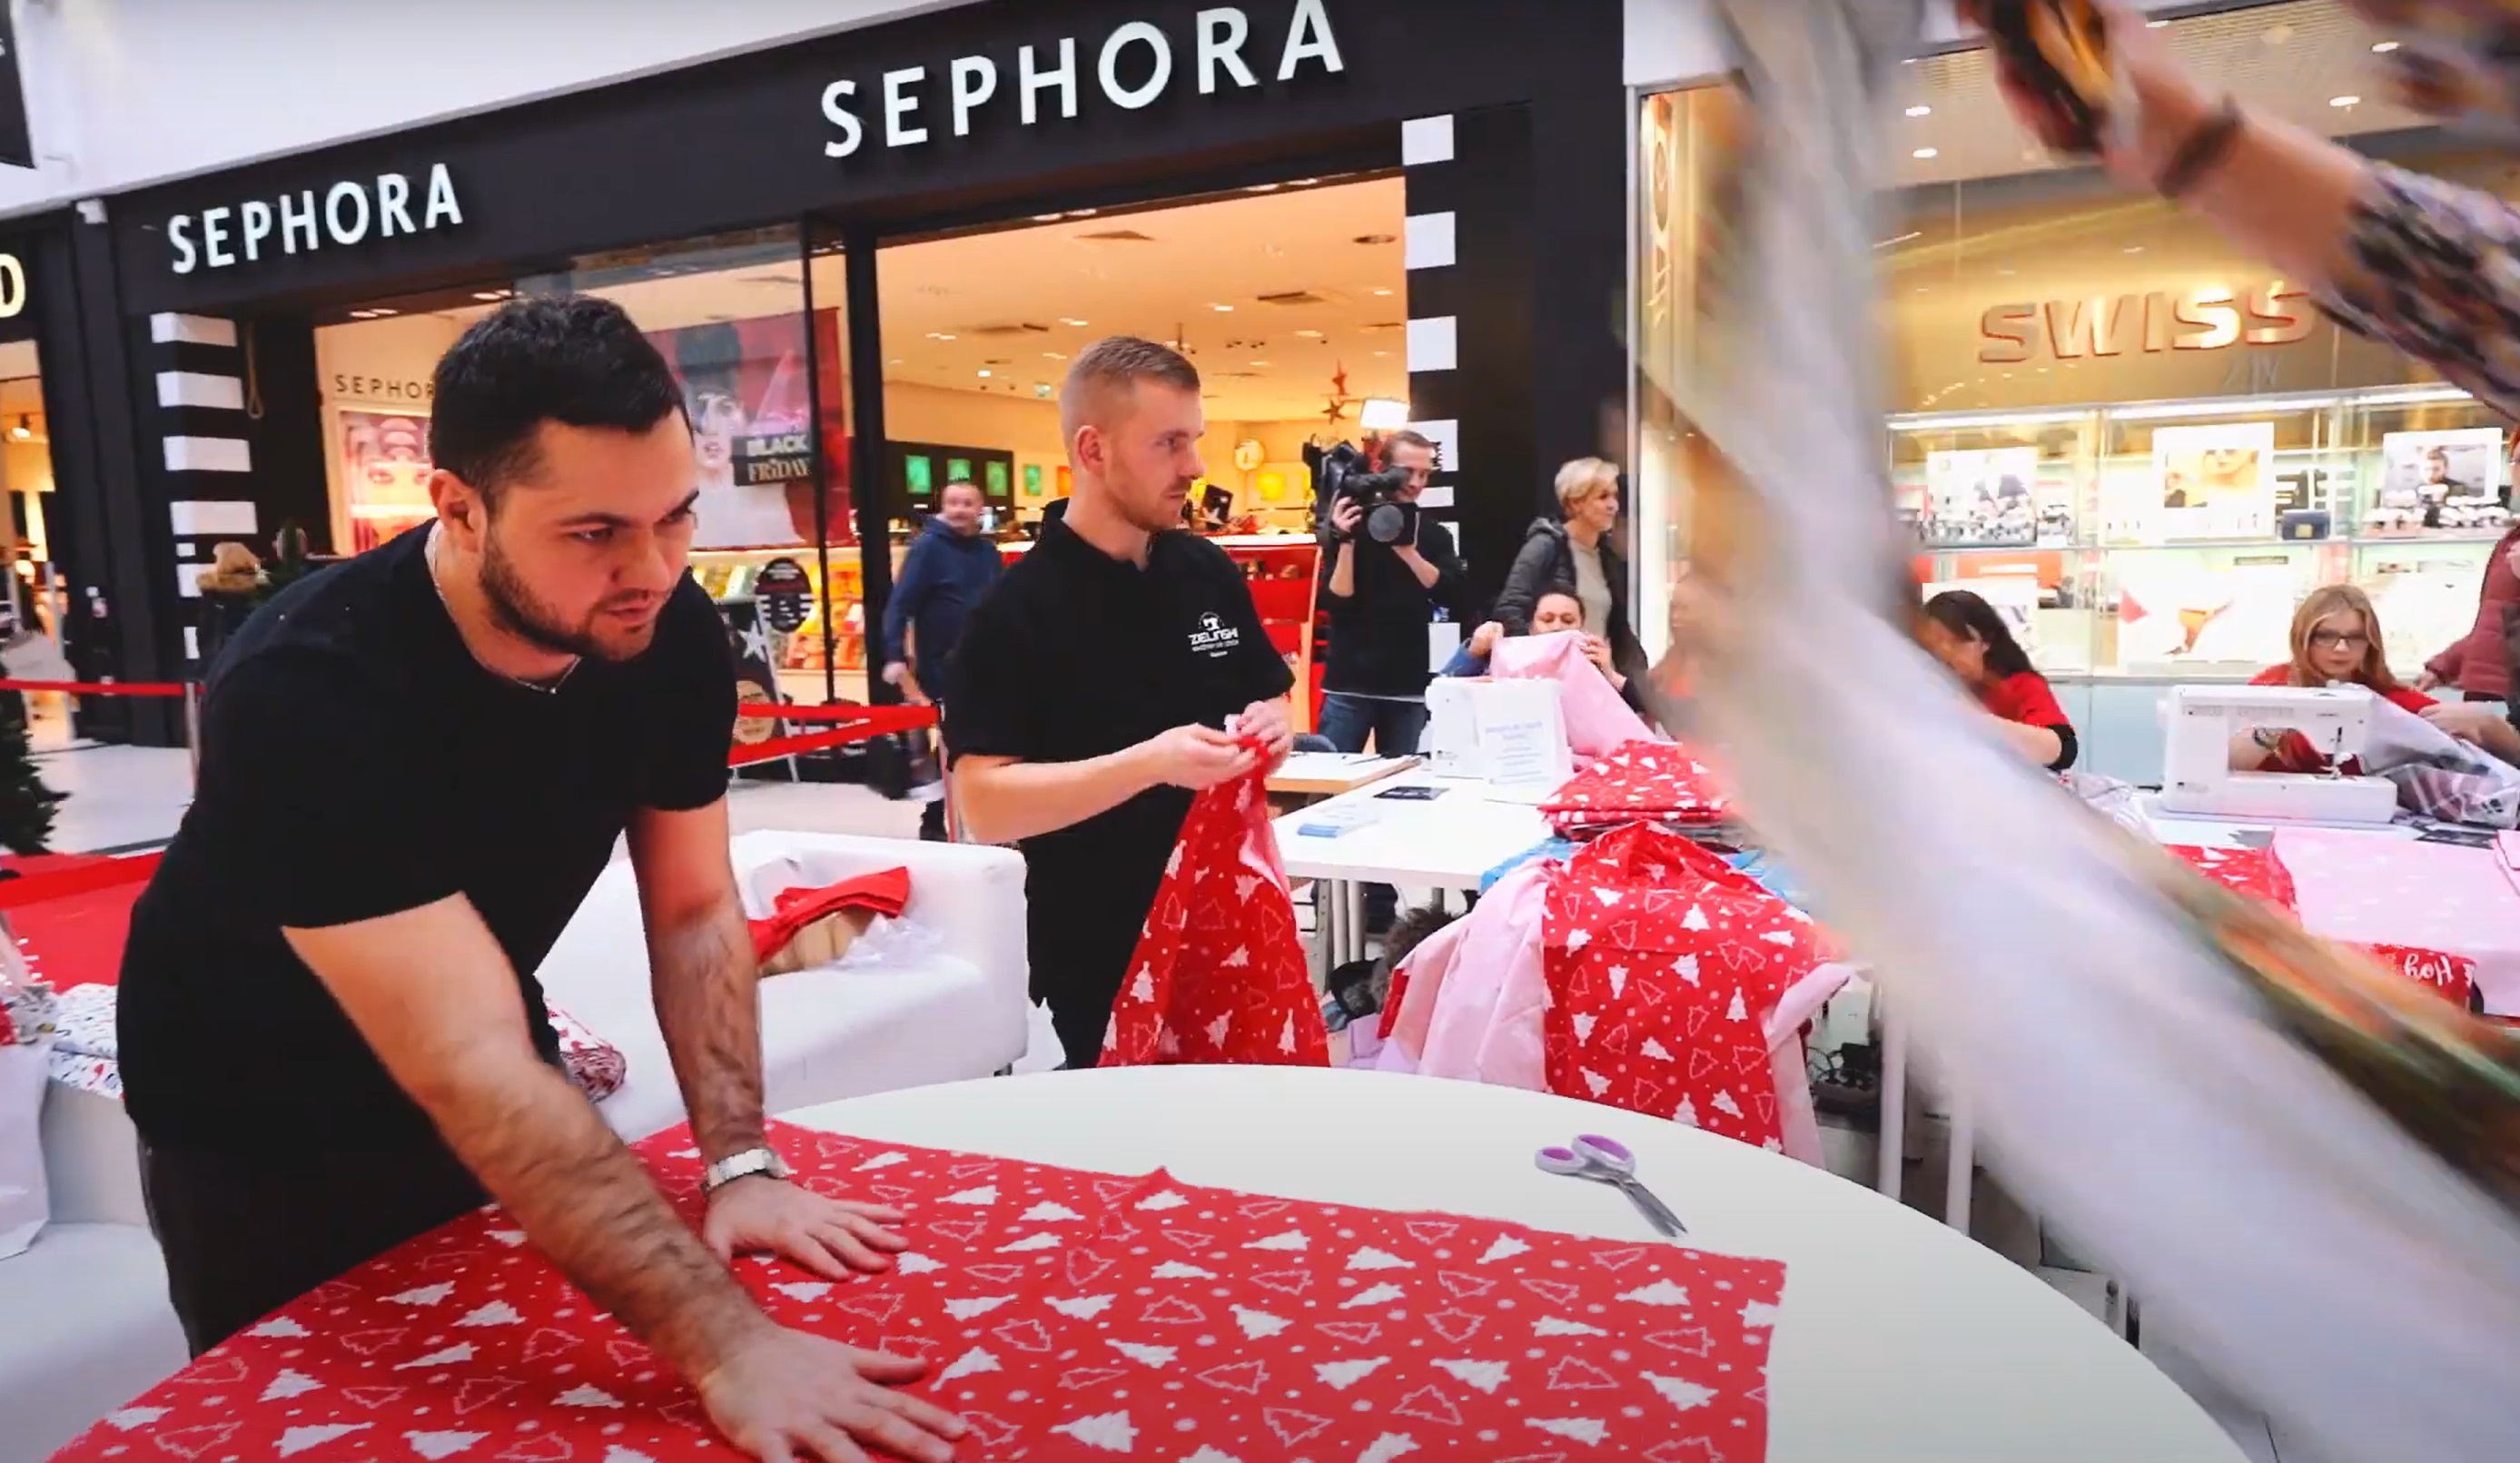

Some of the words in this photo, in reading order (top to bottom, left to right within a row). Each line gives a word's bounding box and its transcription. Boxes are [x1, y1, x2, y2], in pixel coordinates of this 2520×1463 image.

[821, 0, 1344, 157] SEPHORA
[168, 163, 463, 273] SEPHORA
[1979, 279, 2316, 362] SWISS
[746, 434, 809, 457] BLACK
